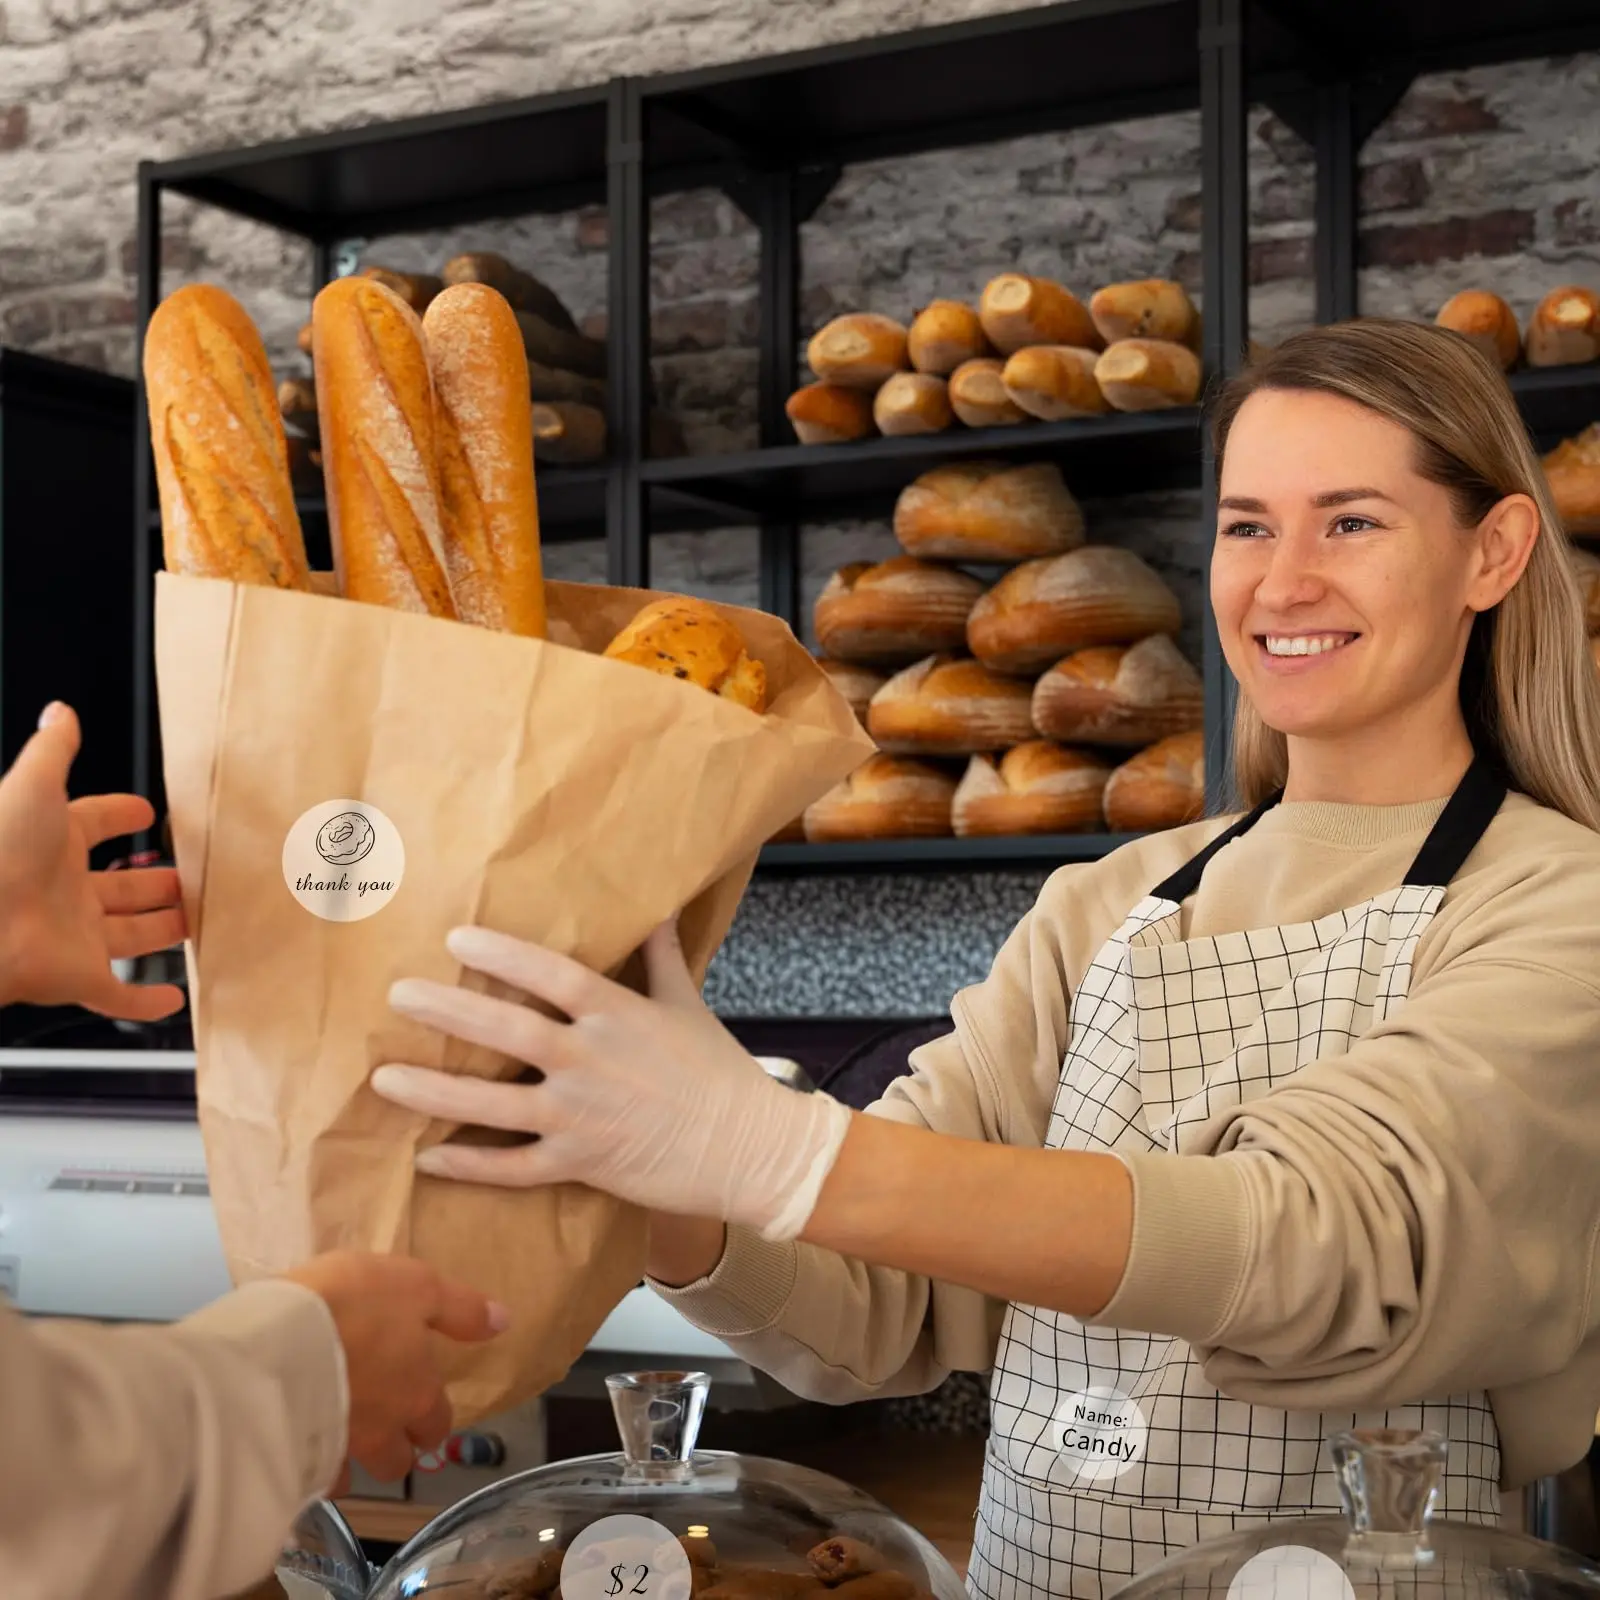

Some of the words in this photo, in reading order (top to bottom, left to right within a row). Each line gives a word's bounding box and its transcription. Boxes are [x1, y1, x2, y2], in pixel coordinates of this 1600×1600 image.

[296, 873, 351, 891] thank
[357, 879, 394, 897] you
[1074, 1404, 1128, 1427] Name:
[1062, 1428, 1137, 1462] Candy
[605, 1563, 650, 1597] $2
